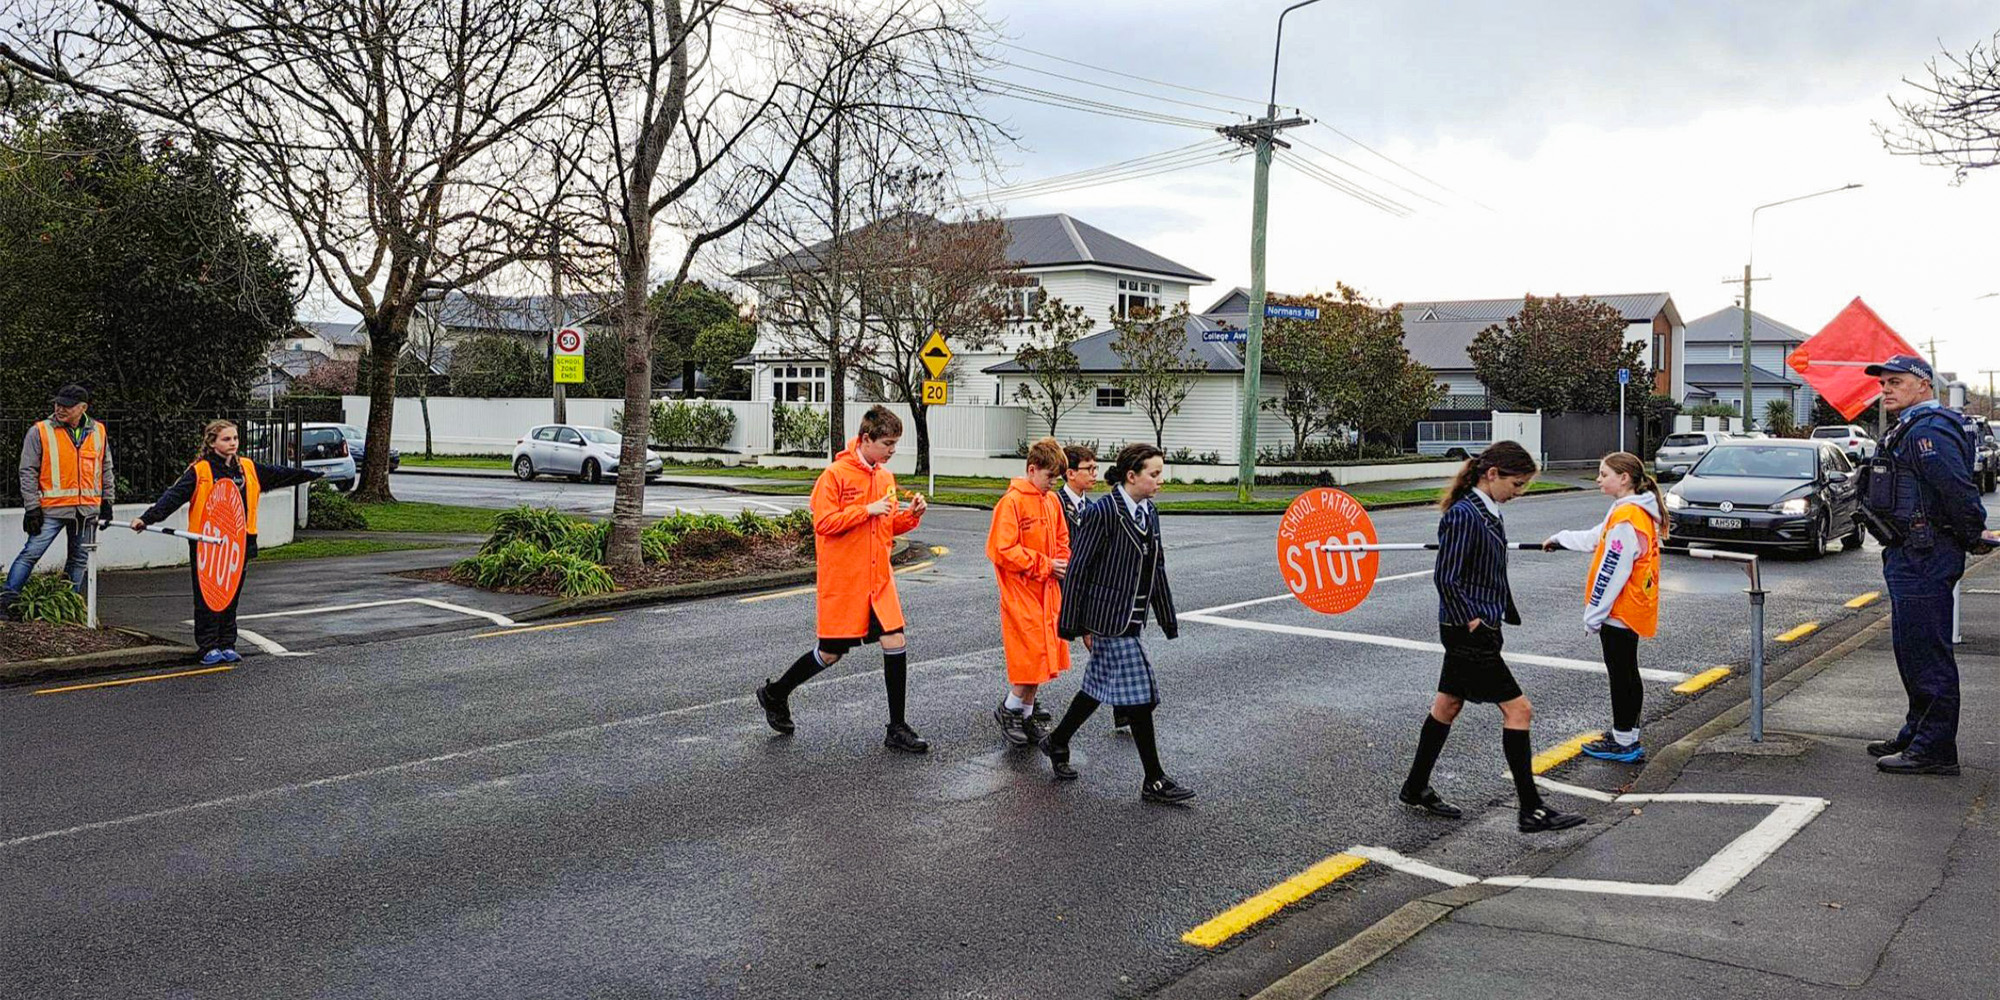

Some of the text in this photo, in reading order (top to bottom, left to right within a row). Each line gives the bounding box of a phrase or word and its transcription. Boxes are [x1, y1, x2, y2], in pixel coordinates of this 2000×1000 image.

[1203, 331, 1247, 341] College Ave
[1268, 306, 1315, 317] Normans Rd
[562, 336, 576, 345] 50
[927, 386, 943, 399] 20
[205, 482, 244, 537] SCHOOL PATROL
[1281, 491, 1362, 541] SCHOOL PATROL
[198, 520, 240, 592] STOP
[1286, 531, 1368, 594] STOP
[1589, 550, 1621, 607] MAUI HAWAII
